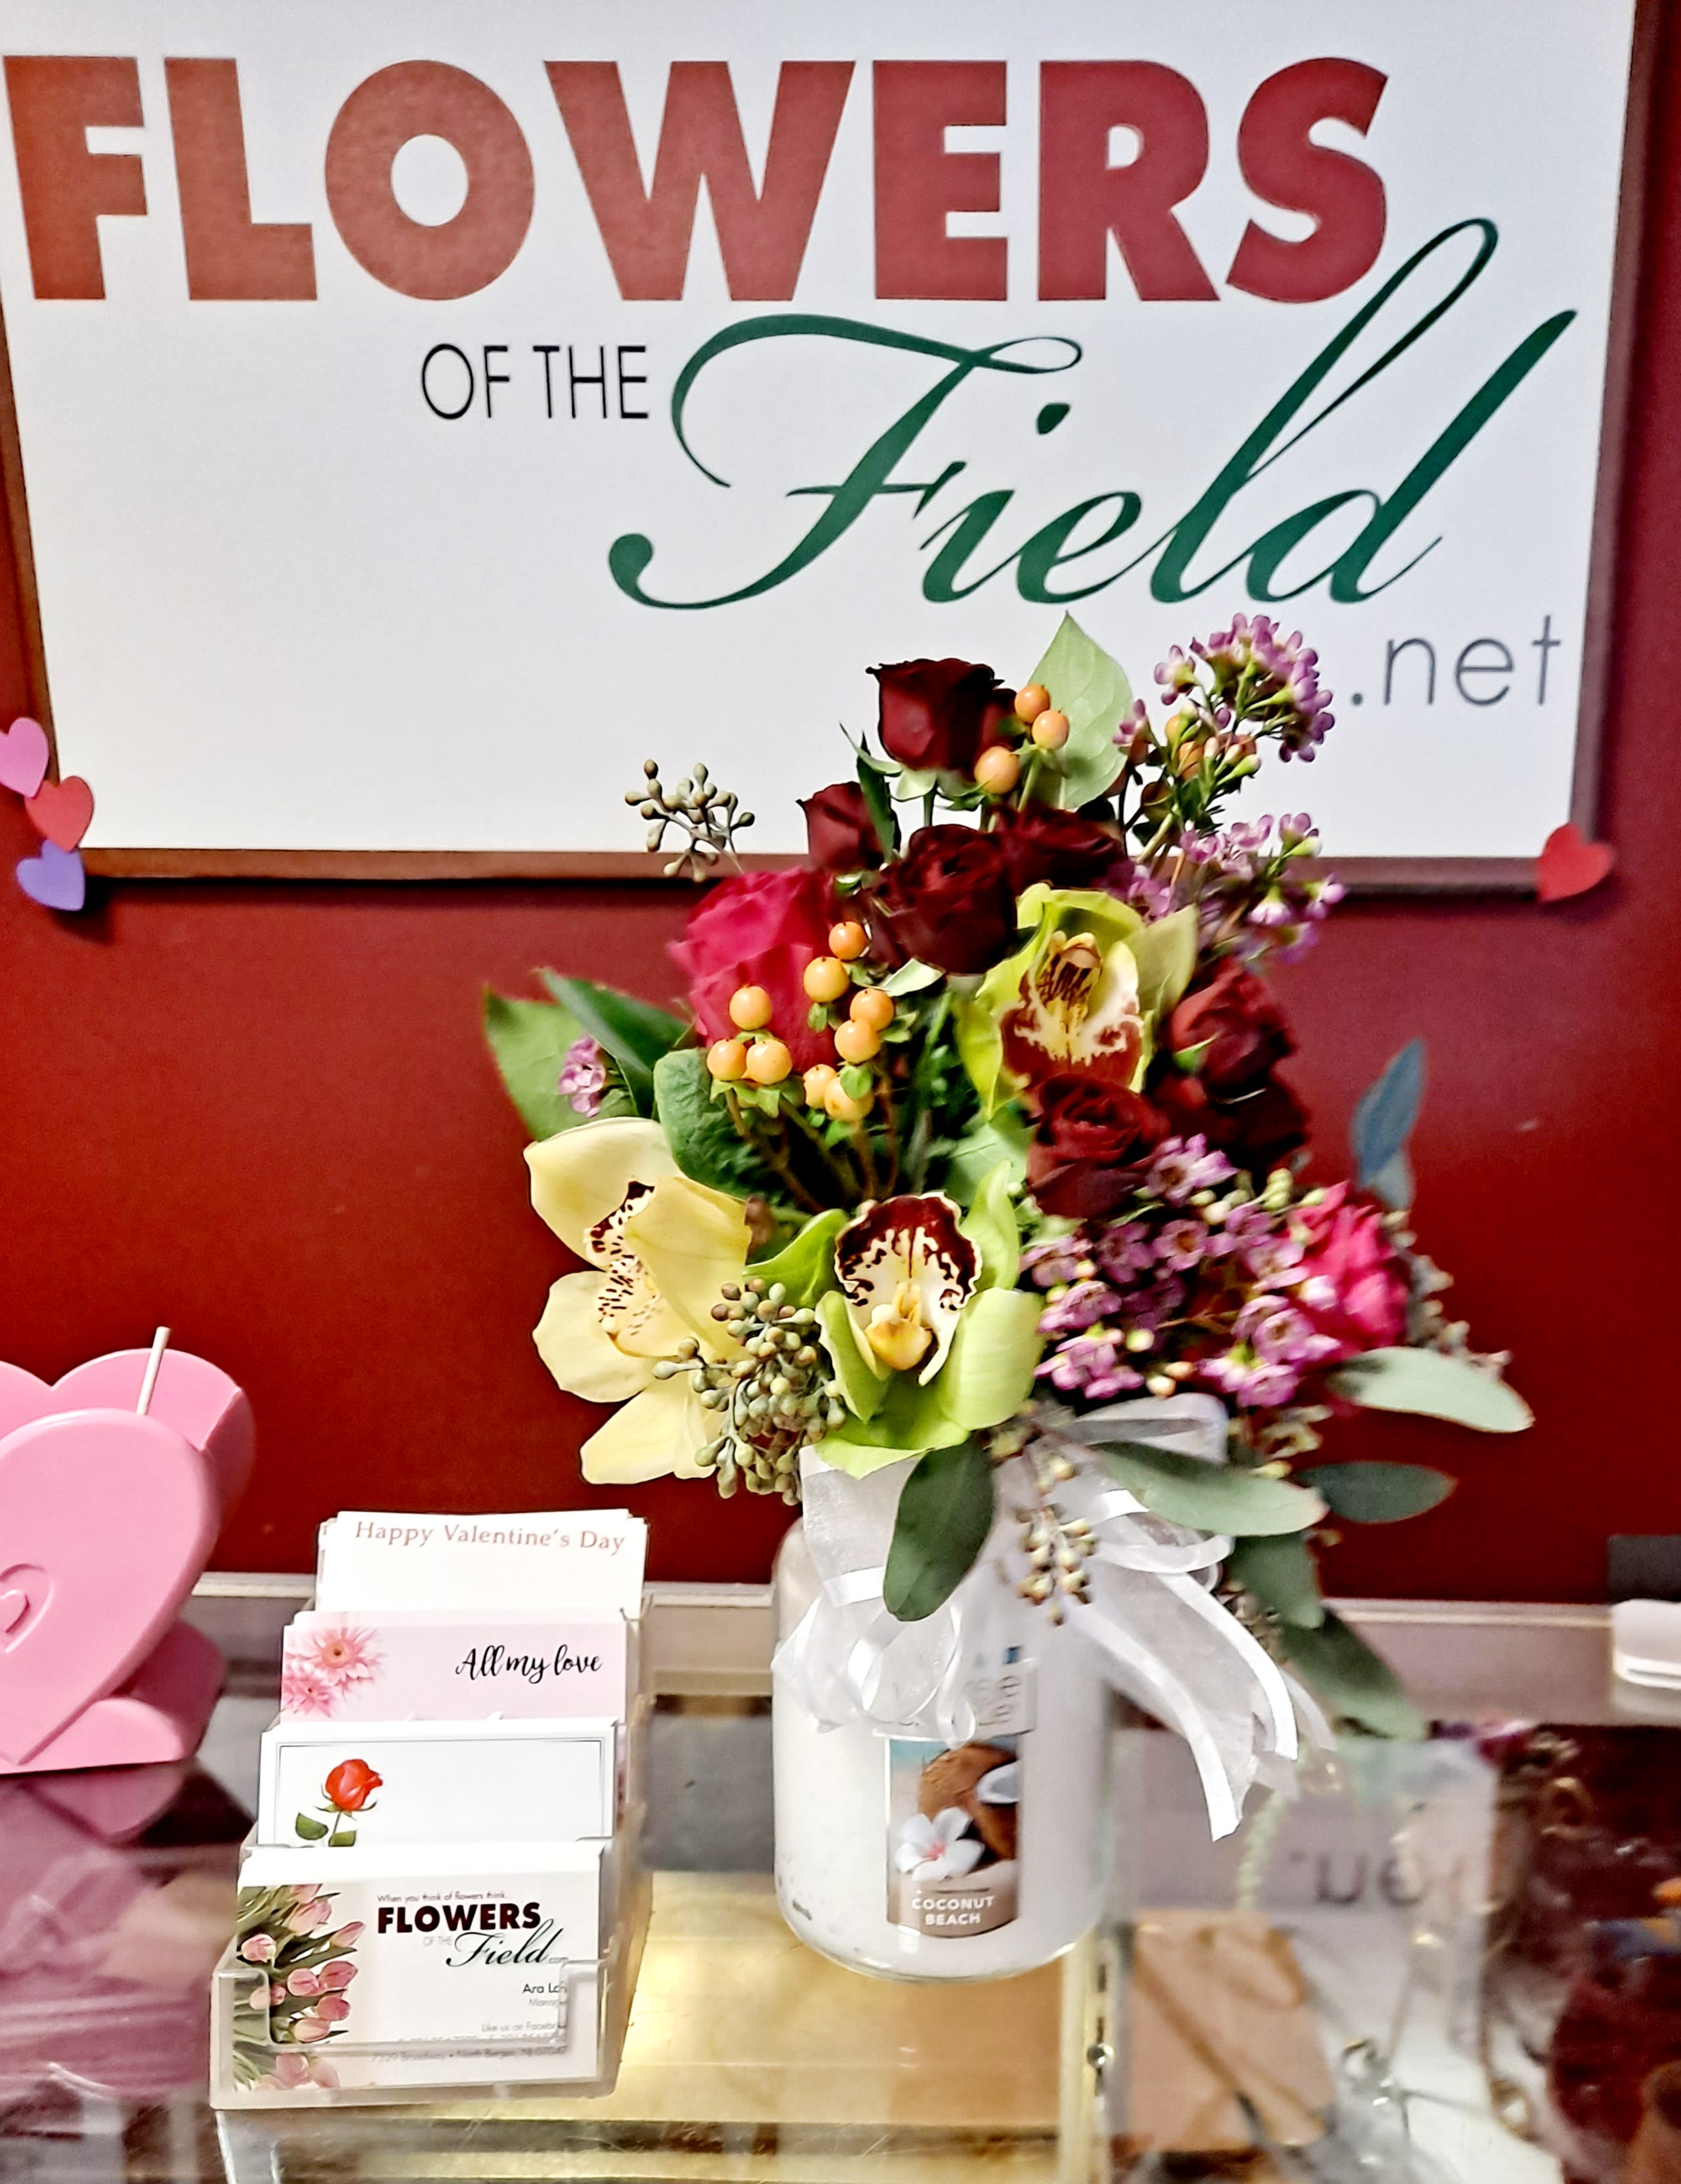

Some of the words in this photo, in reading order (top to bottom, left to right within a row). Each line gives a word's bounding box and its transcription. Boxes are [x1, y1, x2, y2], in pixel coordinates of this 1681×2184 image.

[4, 56, 1389, 303] FLOWERS
[421, 343, 511, 420] OF
[533, 345, 649, 419] THE
[608, 218, 1577, 610] Field
[1351, 615, 1562, 706] .net
[355, 1521, 433, 1547] Happy
[444, 1524, 570, 1547] Valentine's
[580, 1530, 626, 1556] Day
[456, 1645, 504, 1680] All
[506, 1655, 551, 1685] my
[555, 1644, 603, 1676] love
[377, 1902, 541, 1934] FLOWERS
[911, 1895, 996, 1910] COCONUT
[925, 1912, 981, 1926] BEACH
[446, 1918, 564, 1967] Field
[522, 1983, 544, 1994] Ara
